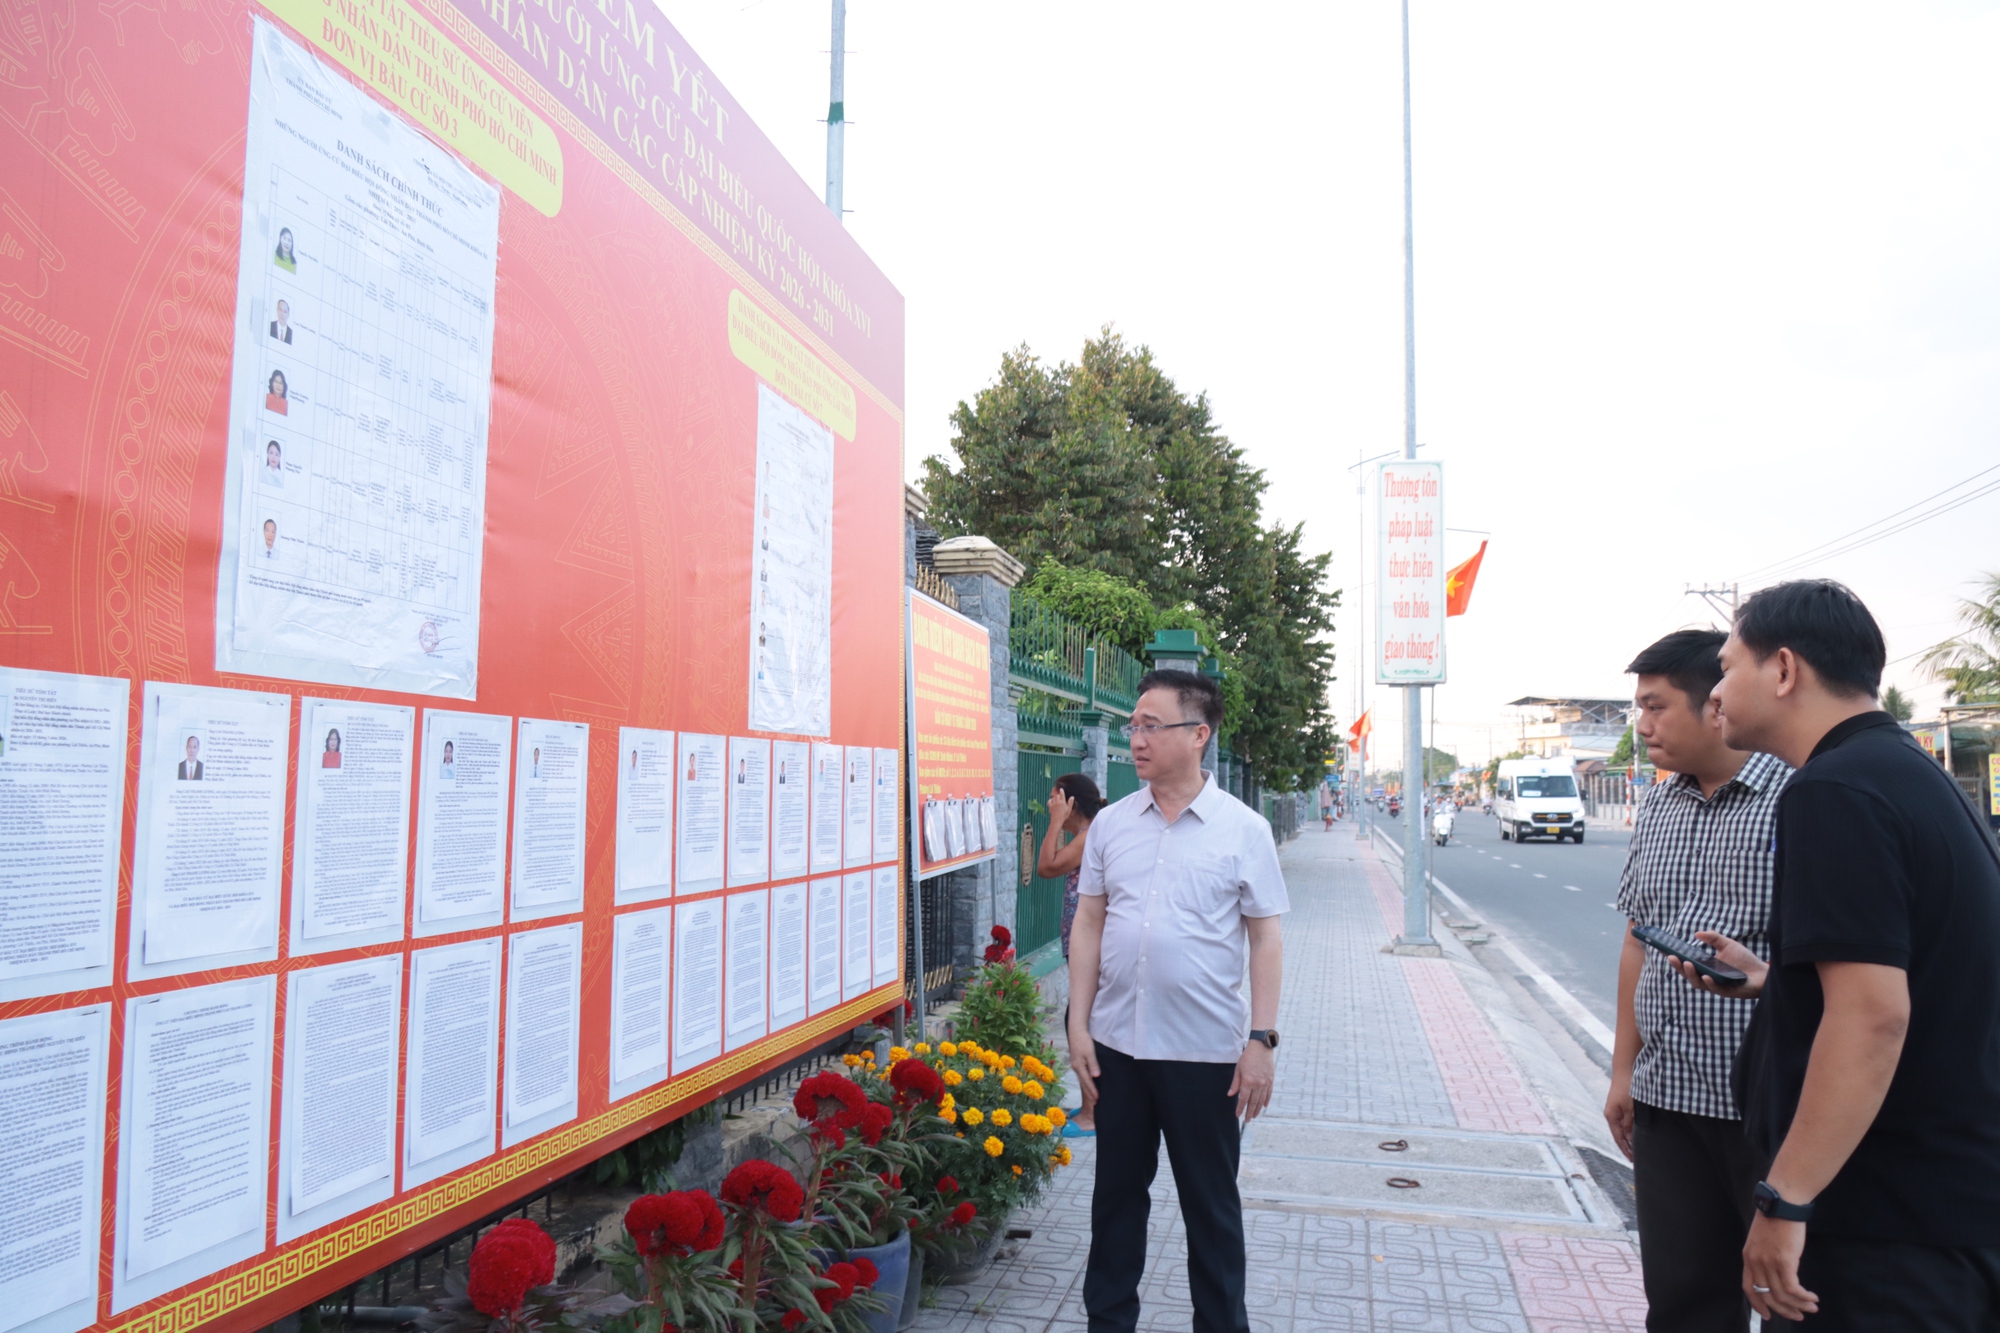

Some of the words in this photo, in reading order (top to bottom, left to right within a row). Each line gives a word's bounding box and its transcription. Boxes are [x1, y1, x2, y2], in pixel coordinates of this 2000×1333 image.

[322, 16, 357, 62] ĐƠN
[359, 45, 375, 82] VỊ
[378, 60, 408, 100] BẦU
[410, 86, 431, 116] CỬ
[432, 103, 449, 131] SỐ
[451, 118, 458, 139] 3
[381, 28, 412, 70] DÂN
[415, 54, 459, 109] THÀNH
[462, 93, 487, 130] PHỐ
[489, 116, 506, 145] HỒ
[507, 133, 528, 163] CHÍ
[529, 148, 557, 186] MINH
[410, 17, 440, 60] TIỂU
[442, 47, 460, 75] SỬ
[461, 59, 488, 101] ỨNG
[489, 89, 508, 115] CỬ
[508, 101, 534, 139] VIÊN
[664, 43, 730, 146] YẾT
[337, 138, 364, 166] DANH
[365, 158, 390, 183] SÁCH
[391, 176, 419, 203] CHÍNH
[420, 194, 444, 218] THỨC
[481, 0, 551, 71] HÂN
[557, 45, 608, 124] DÂN
[613, 105, 657, 170] CÁC
[661, 152, 698, 207] CẤP
[701, 187, 754, 263] NHIỆM
[757, 243, 777, 283] KỲ
[780, 266, 805, 310] 2026
[813, 298, 836, 338] 2031
[599, 32, 647, 111] ỨNG
[651, 95, 680, 142] CỬ
[683, 124, 714, 182] ĐẠI
[718, 160, 754, 220] BIỂU
[757, 203, 796, 262] QUỐC
[798, 245, 820, 288] HỘI
[822, 269, 853, 322] KHÓA
[854, 302, 872, 339] XVI
[1384, 472, 1420, 505] Thượng
[1388, 512, 1412, 544] pháp
[1414, 512, 1433, 545] luật
[1389, 552, 1411, 585] thực
[1412, 552, 1433, 585] hiện
[1393, 593, 1410, 618] văn
[1412, 592, 1430, 618] hóa
[1384, 633, 1405, 665] giao
